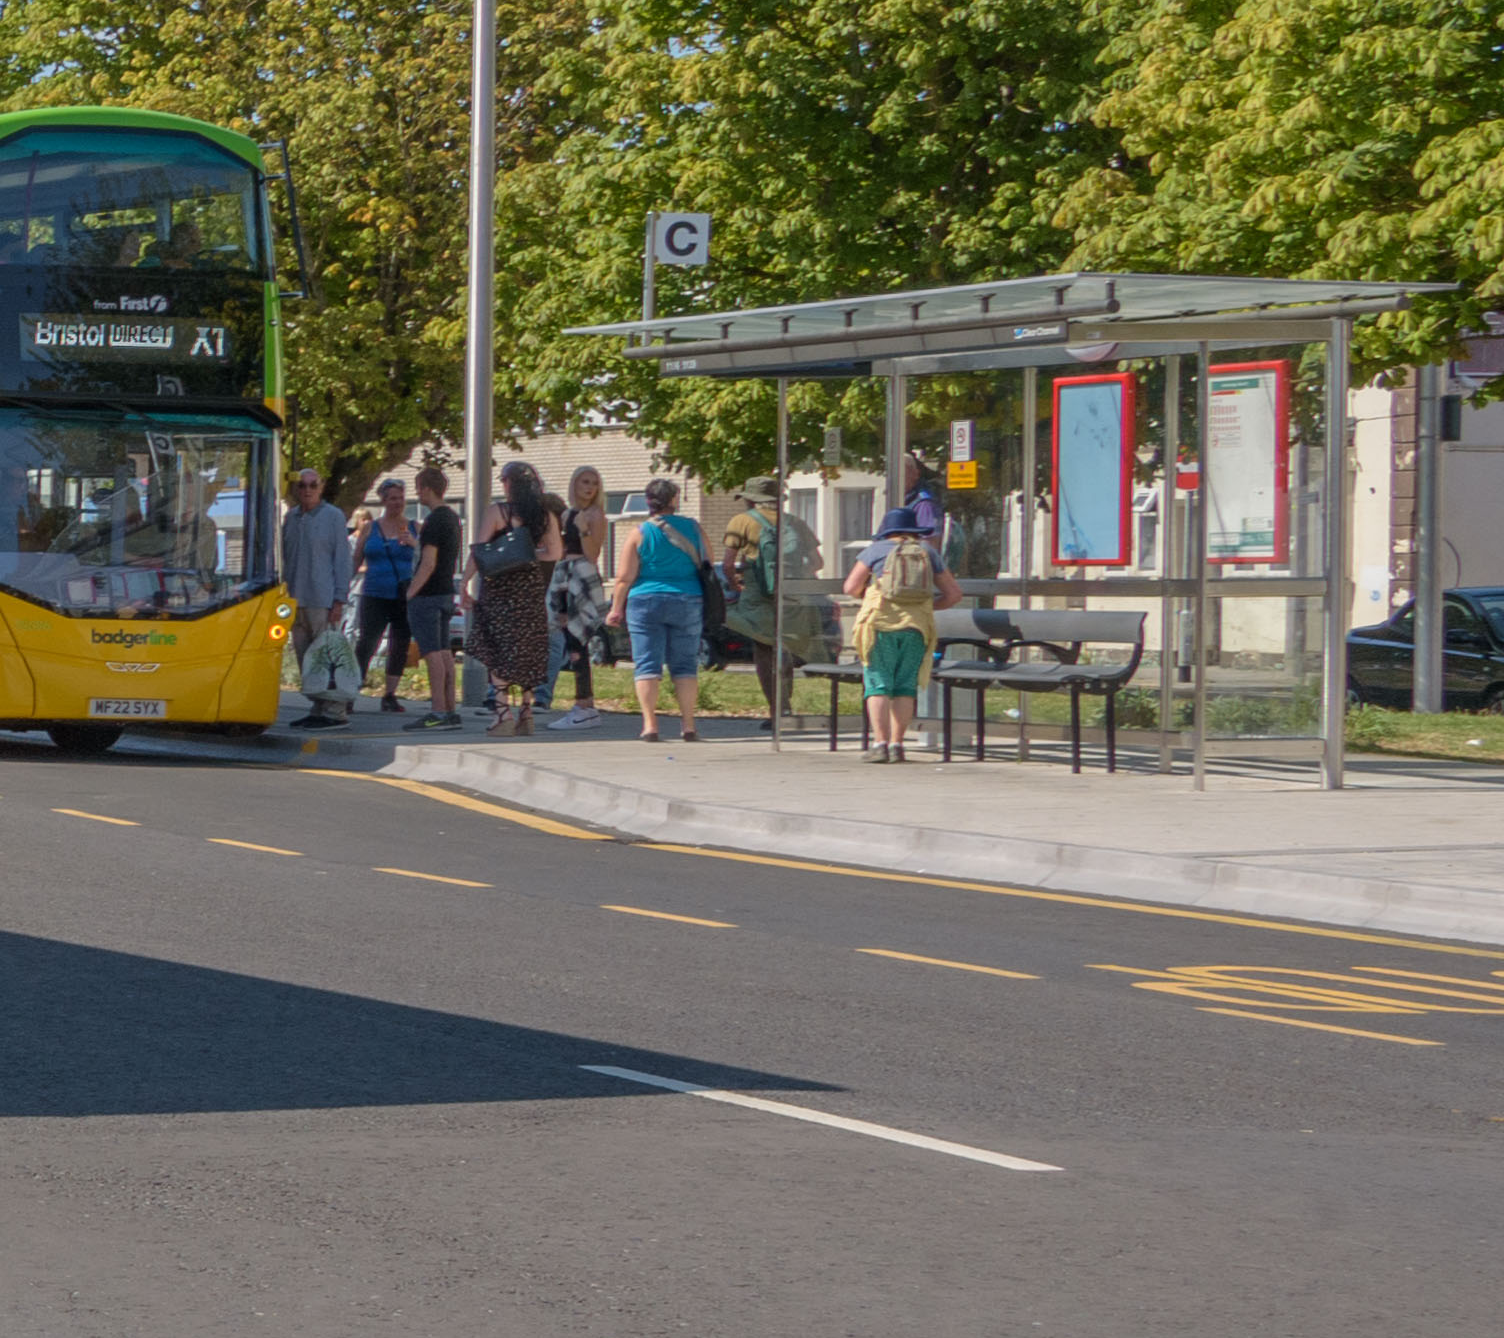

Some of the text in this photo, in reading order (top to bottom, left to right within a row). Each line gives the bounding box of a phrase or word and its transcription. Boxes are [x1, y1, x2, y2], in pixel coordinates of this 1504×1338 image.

[664, 222, 698, 258] C
[93, 295, 149, 310] from First
[35, 322, 105, 346] Bristol
[190, 327, 226, 356] X1
[91, 629, 177, 648] badgerline
[95, 700, 160, 715] MF22 SYX
